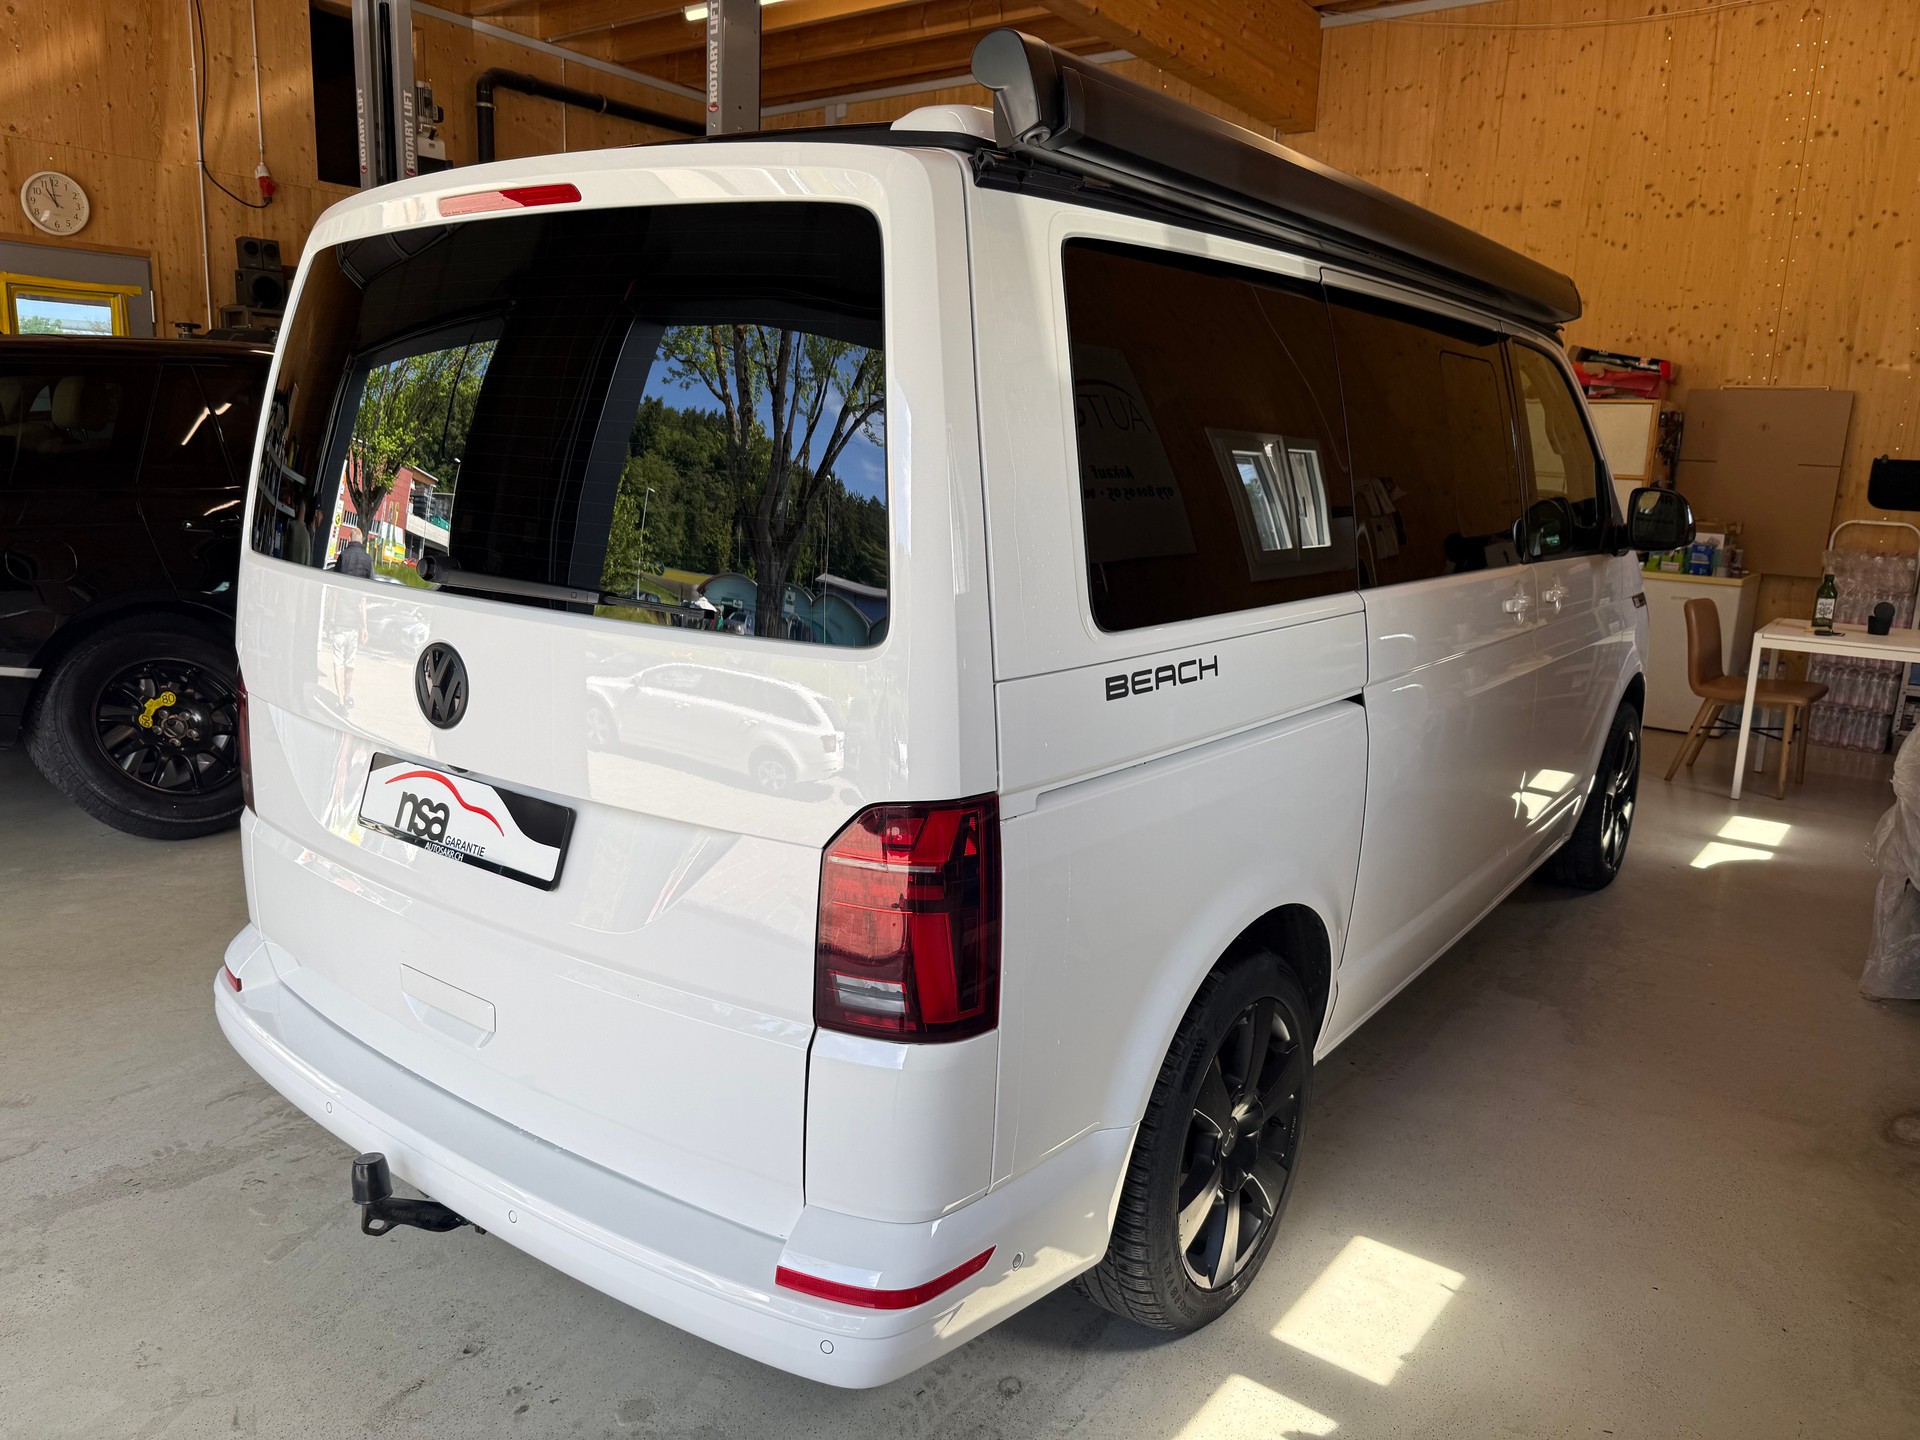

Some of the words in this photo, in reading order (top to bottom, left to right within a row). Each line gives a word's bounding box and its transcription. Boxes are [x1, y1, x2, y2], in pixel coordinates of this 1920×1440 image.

[710, 1, 719, 35] LIFT
[709, 40, 719, 103] ROTARY
[403, 90, 413, 117] LIFT
[358, 118, 367, 166] ROTARY
[404, 120, 415, 169] ROTARY
[30, 197, 36, 205] 9
[33, 187, 41, 195] 10
[72, 192, 78, 200] 2
[76, 203, 81, 211] 3
[1104, 654, 1219, 702] BEACH
[162, 693, 175, 703] 80
[141, 714, 151, 728] 50
[394, 791, 450, 843] nsa
[444, 835, 486, 857] GARANTIE
